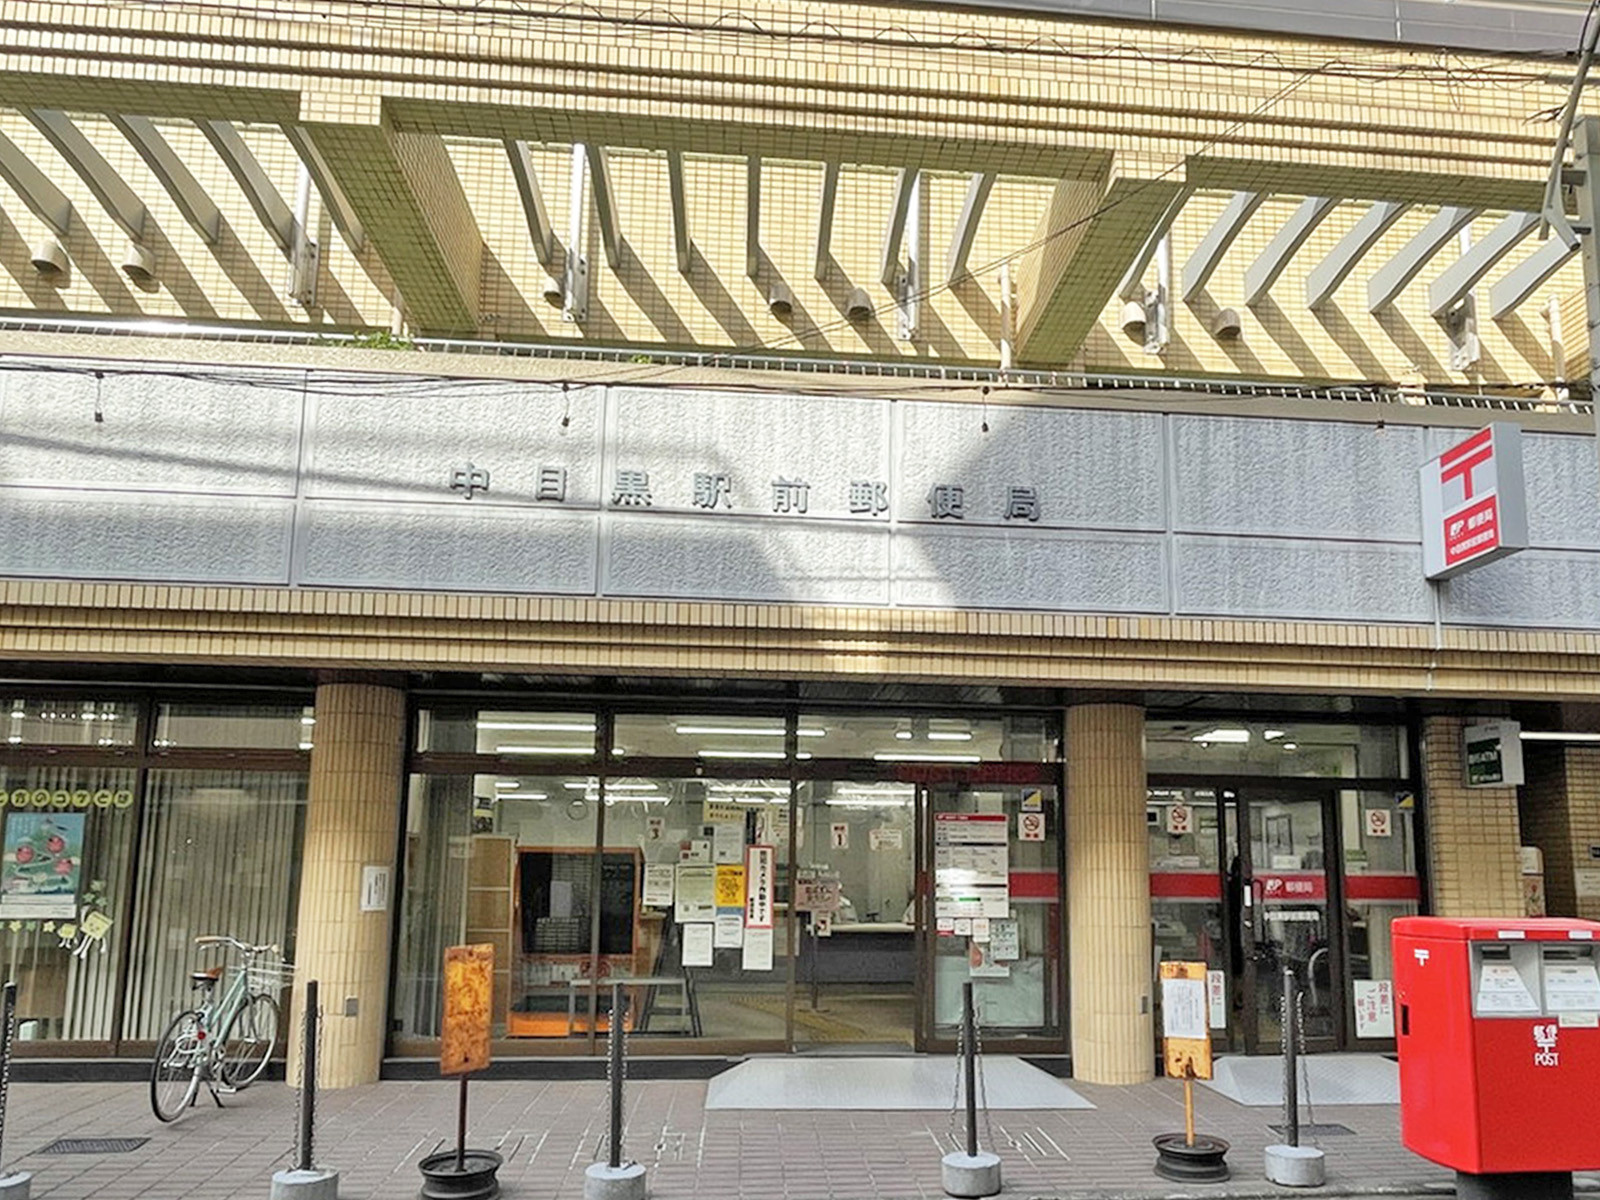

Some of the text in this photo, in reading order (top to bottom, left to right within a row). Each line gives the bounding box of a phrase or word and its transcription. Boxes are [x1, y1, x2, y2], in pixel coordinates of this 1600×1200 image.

[449, 463, 1041, 523] 中目黒駅前郵便局
[1533, 1024, 1559, 1041] 郵便
[1534, 1052, 1560, 1066] POST
